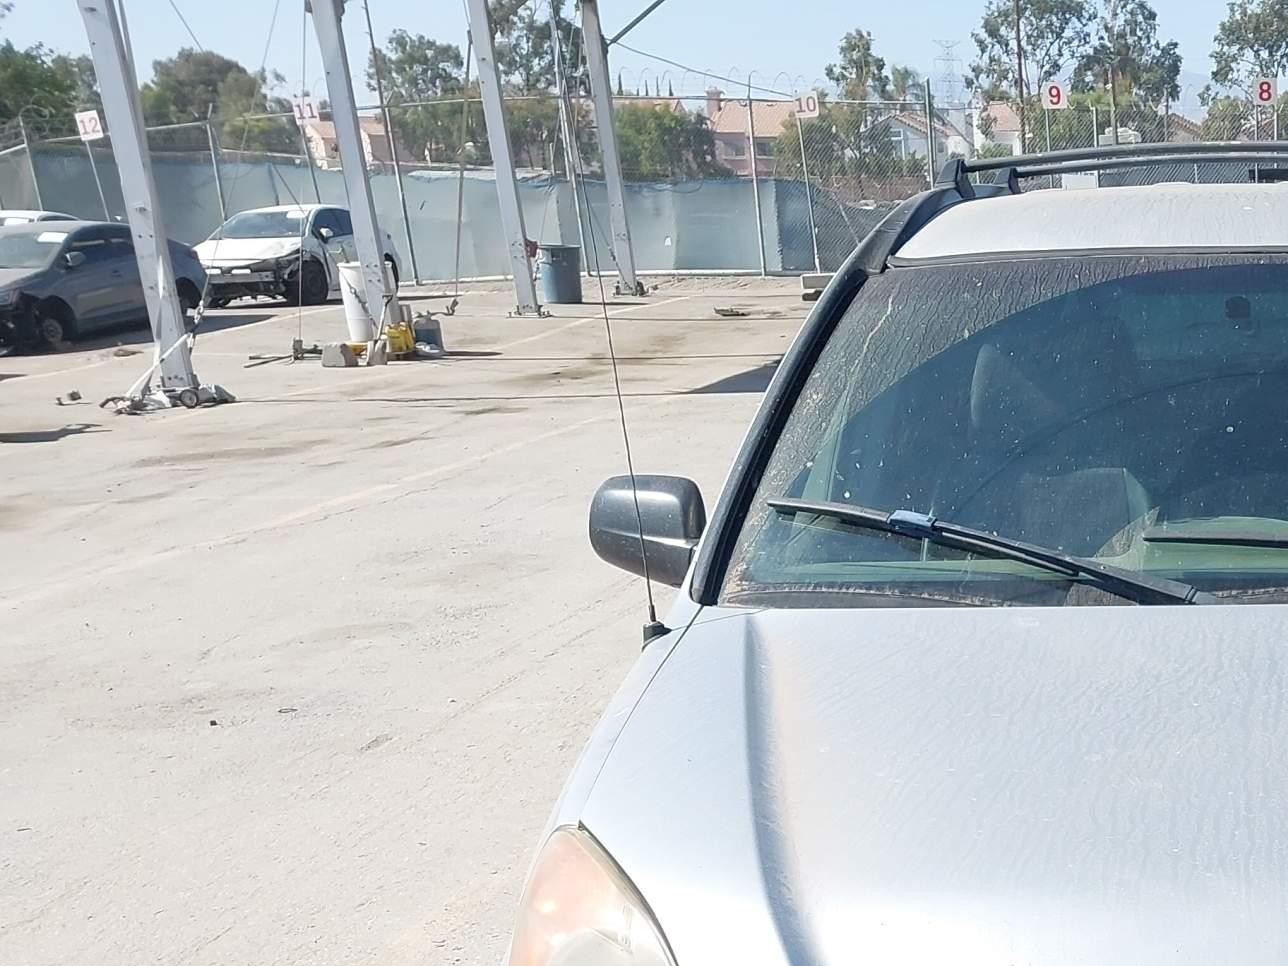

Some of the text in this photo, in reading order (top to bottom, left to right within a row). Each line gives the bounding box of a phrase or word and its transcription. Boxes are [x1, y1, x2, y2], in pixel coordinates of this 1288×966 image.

[1048, 85, 1061, 105] 9
[1259, 81, 1271, 101] 8
[294, 102, 317, 119] 11
[795, 96, 816, 113] 10
[80, 117, 101, 135] 12
